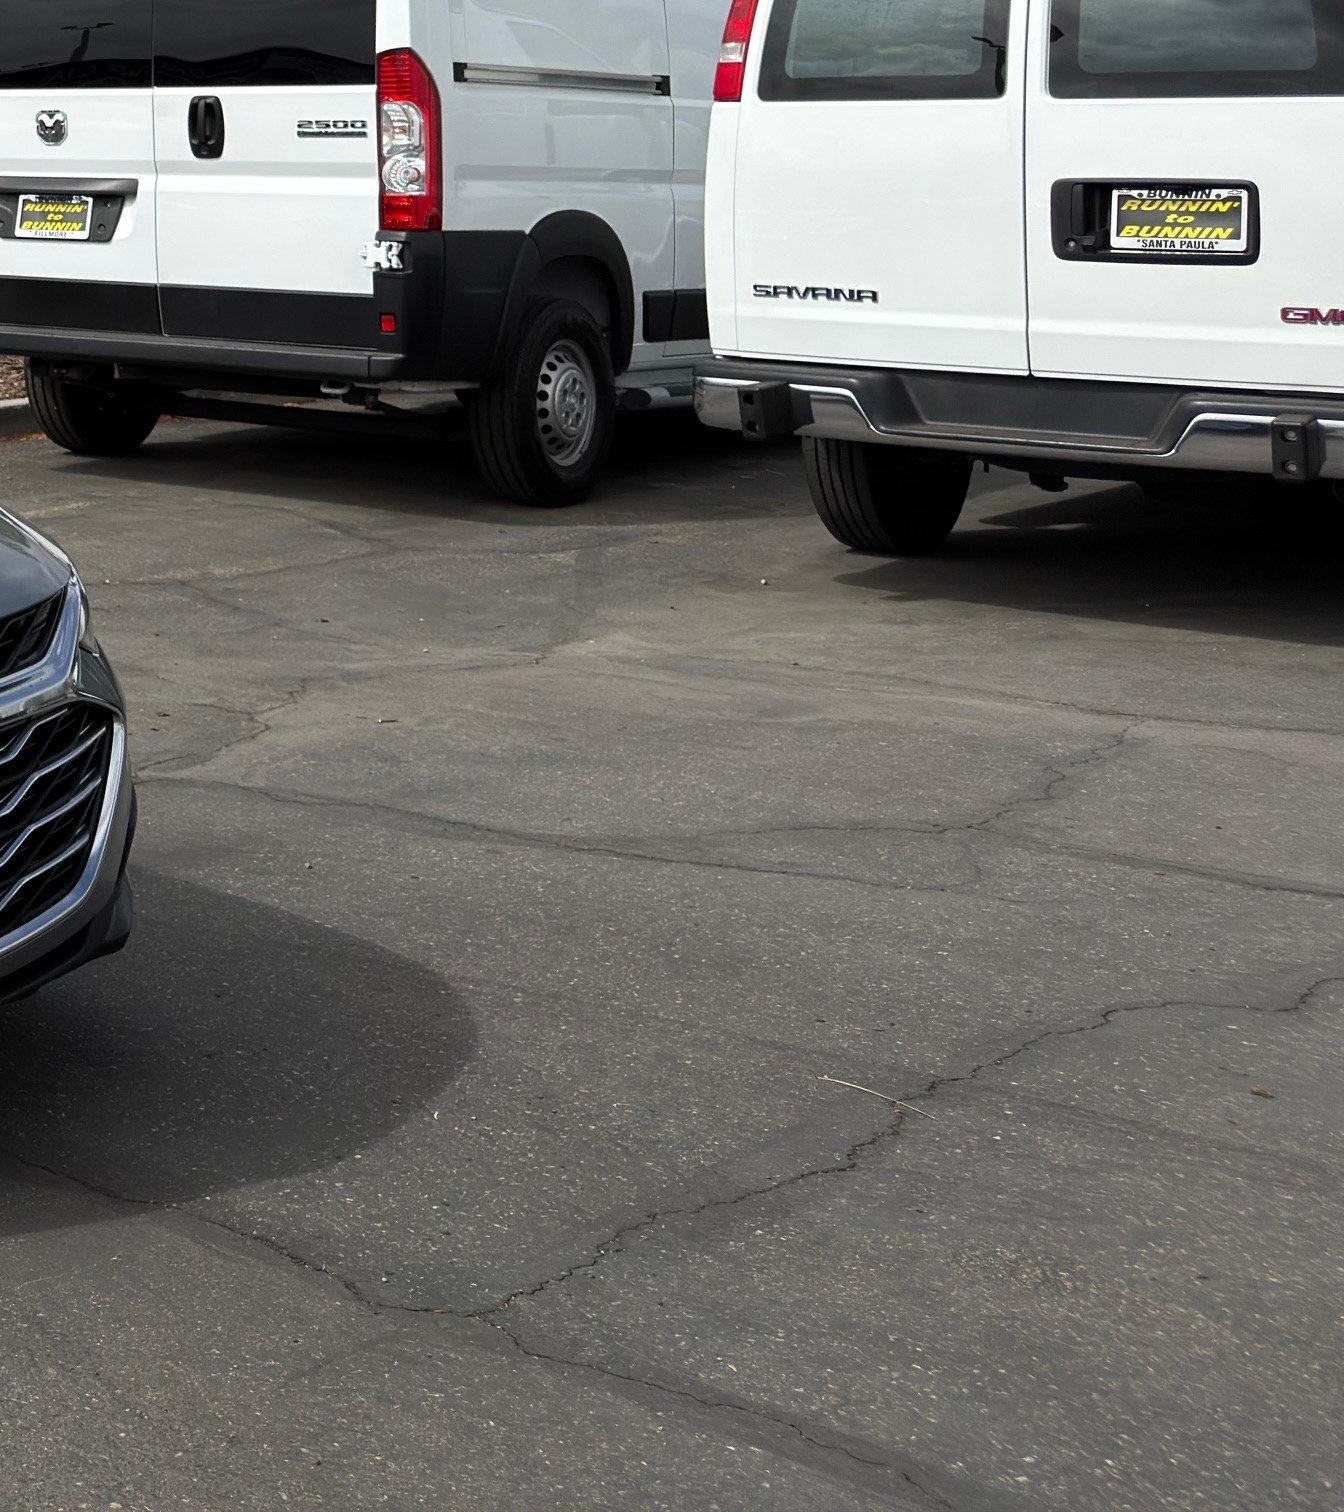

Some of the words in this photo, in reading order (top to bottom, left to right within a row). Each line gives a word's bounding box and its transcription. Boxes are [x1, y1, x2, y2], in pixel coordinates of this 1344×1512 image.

[297, 120, 368, 130] 2500
[23, 203, 87, 213] RUNNIN'
[1120, 199, 1241, 213] RUNNIN'
[47, 213, 64, 221] to
[1165, 214, 1195, 223] to
[20, 220, 83, 231] BUNNIN
[1119, 226, 1234, 239] BUNNIN
[752, 284, 879, 304] SAVANA
[1280, 307, 1344, 326] GM
